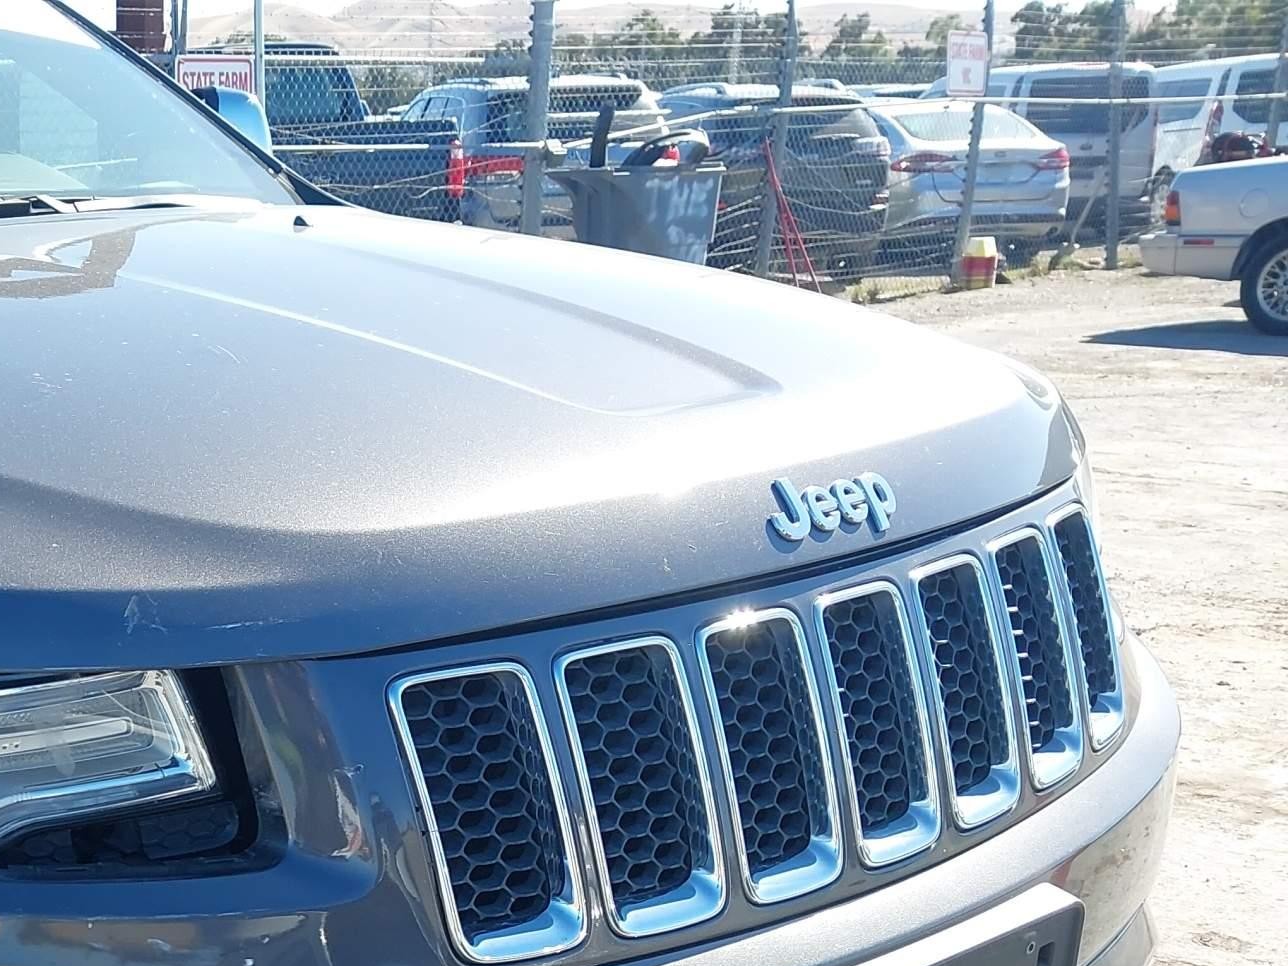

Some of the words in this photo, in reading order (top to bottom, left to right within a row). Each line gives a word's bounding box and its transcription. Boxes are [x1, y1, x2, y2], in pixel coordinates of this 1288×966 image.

[182, 71, 215, 90] STATE
[218, 71, 249, 92] FARM
[765, 471, 898, 542] Jeep
